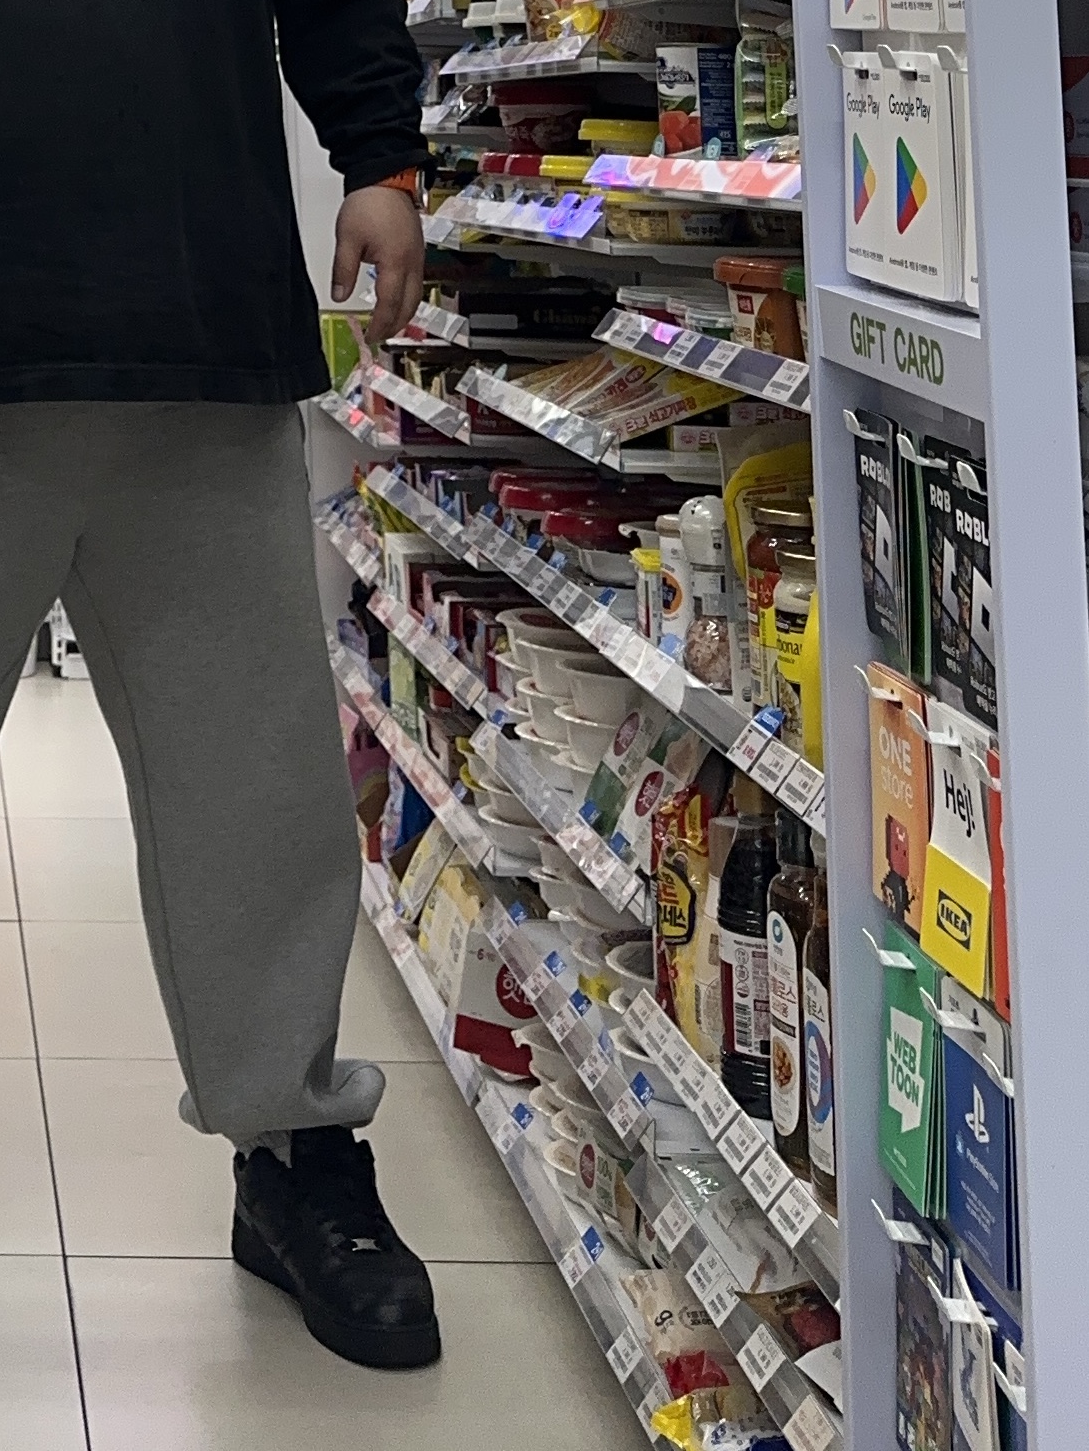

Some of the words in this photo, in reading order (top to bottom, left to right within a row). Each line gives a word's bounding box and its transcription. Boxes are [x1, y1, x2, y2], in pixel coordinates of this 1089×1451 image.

[846, 92, 866, 117] Google
[866, 95, 881, 120] Play
[888, 94, 915, 122] Google
[915, 96, 931, 124] Play
[849, 310, 887, 366] GIFT
[893, 325, 945, 386] CARD
[859, 453, 891, 490] ROBL
[929, 483, 952, 514] ROB
[955, 508, 990, 547] ROBL
[878, 726, 912, 775] ONE
[942, 768, 976, 838] Hej!
[938, 901, 971, 942] IKEA
[893, 1030, 917, 1074] WEB
[889, 1057, 921, 1108] TOON
